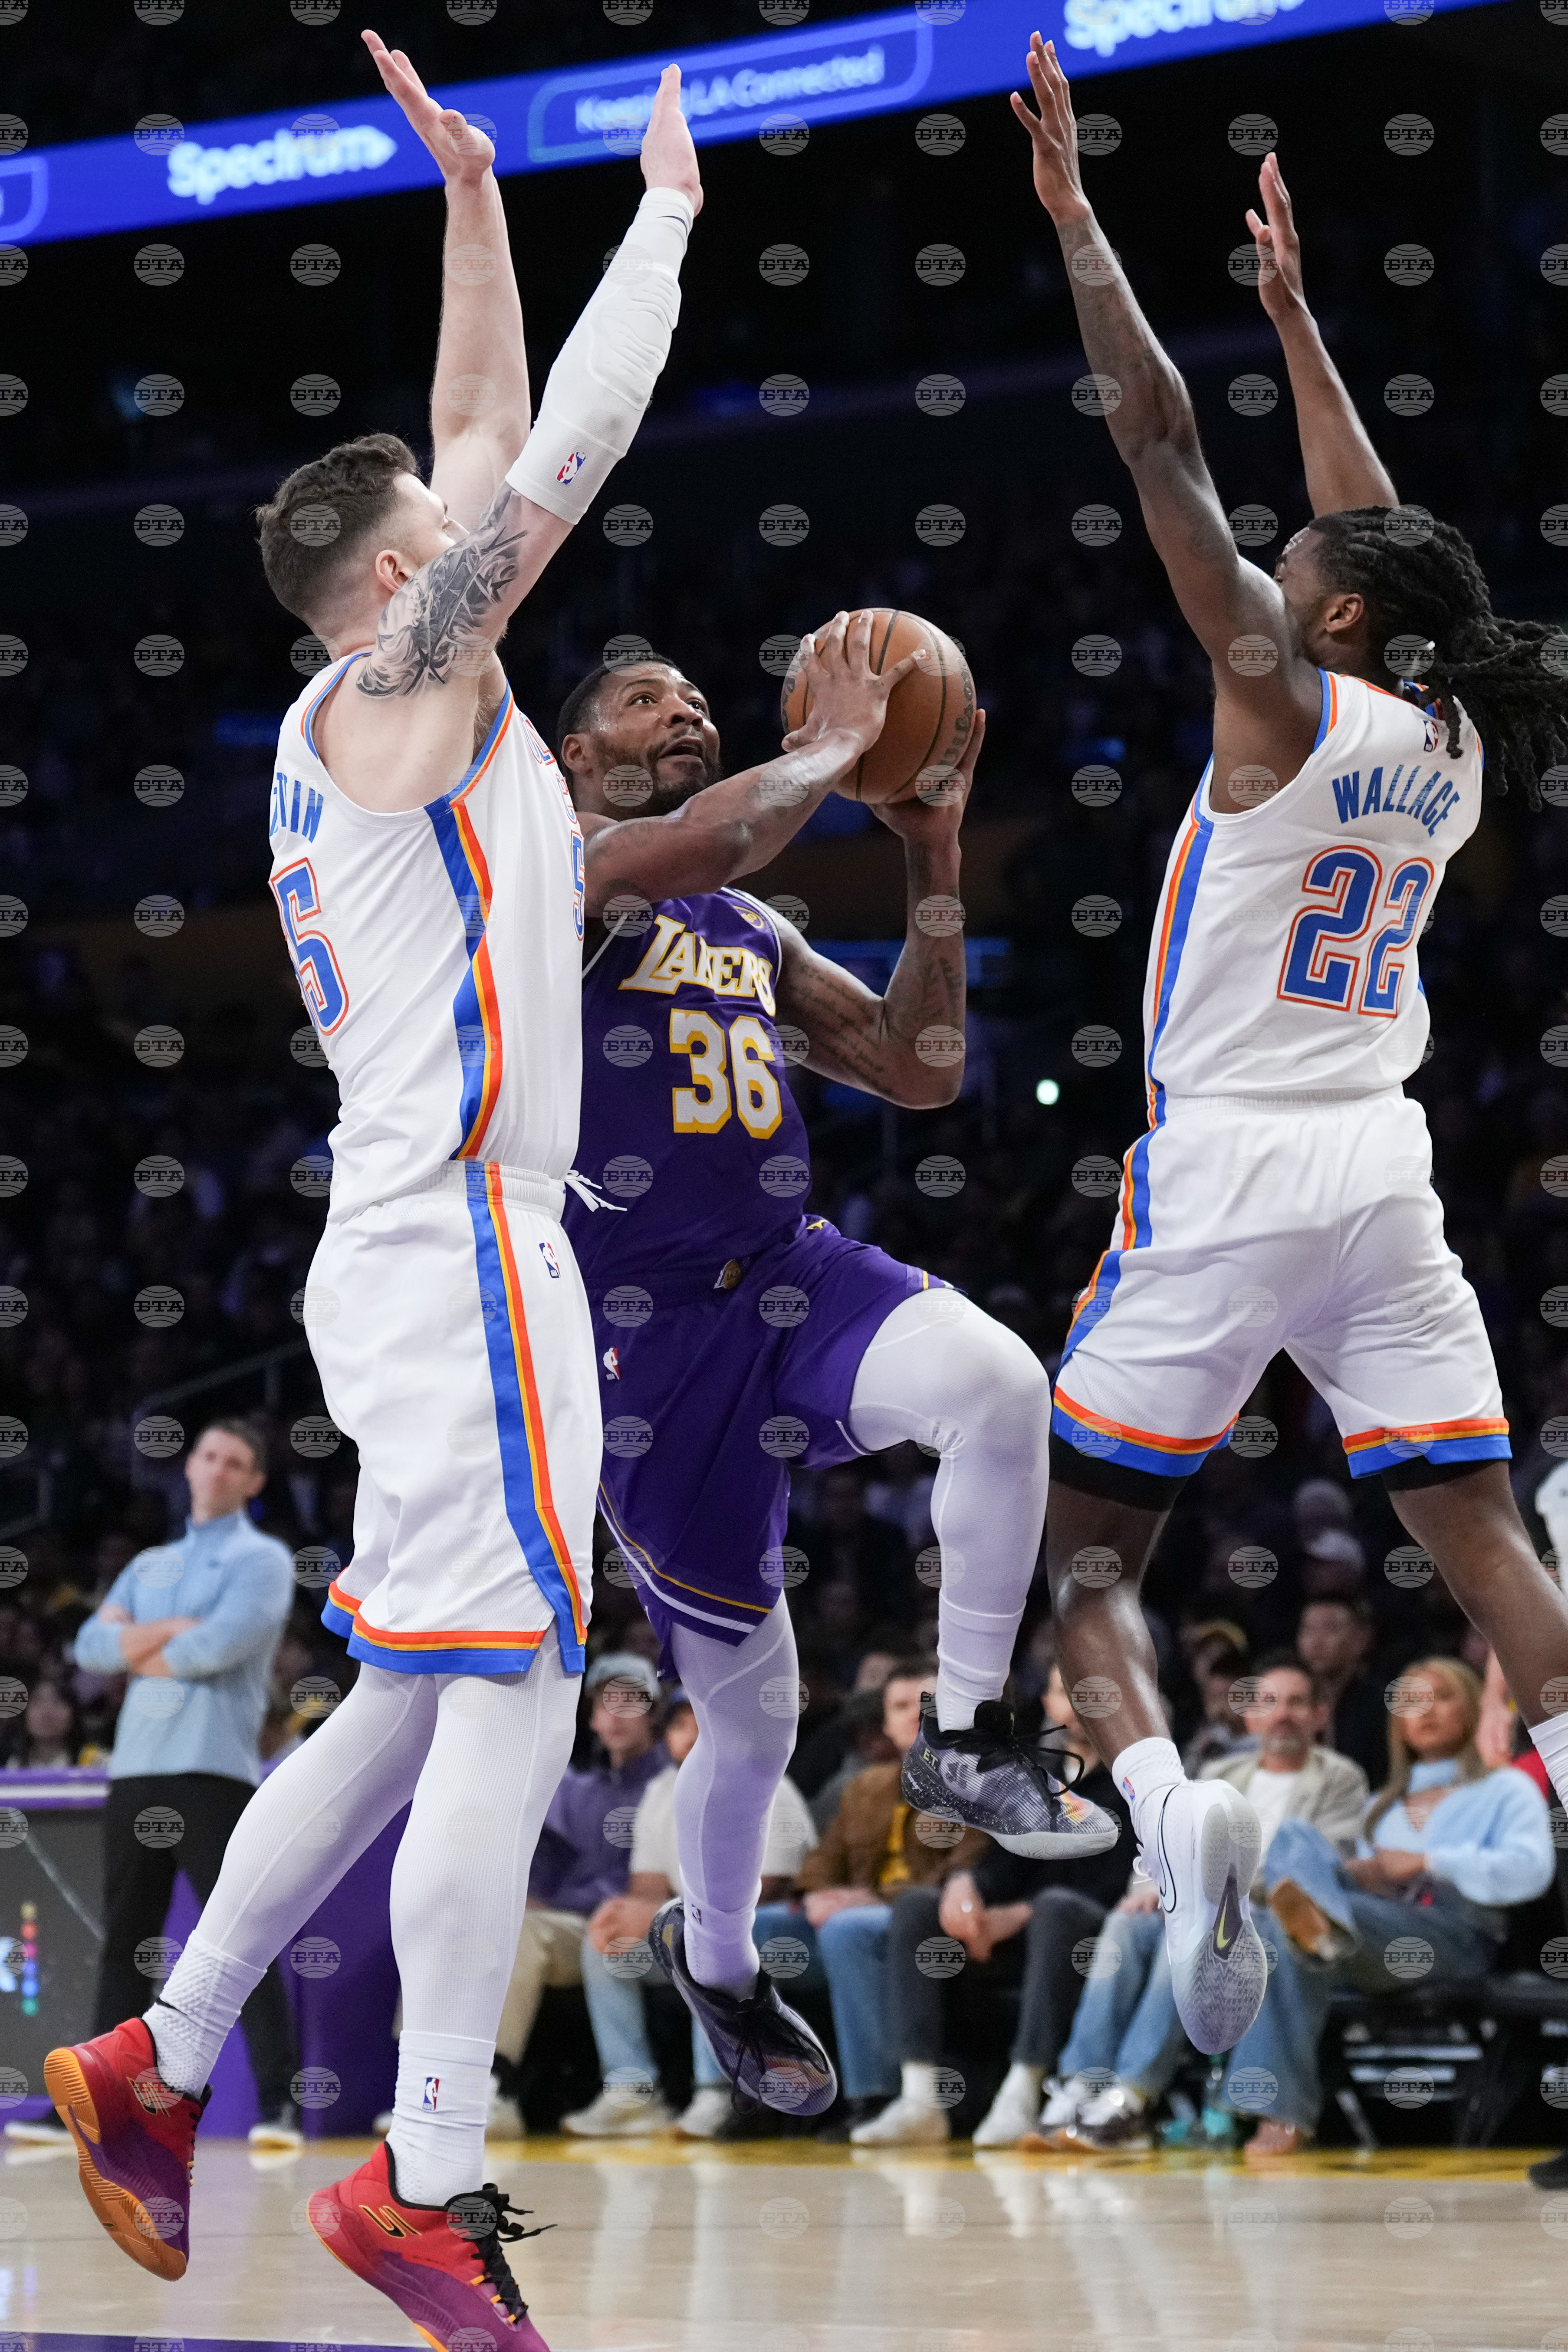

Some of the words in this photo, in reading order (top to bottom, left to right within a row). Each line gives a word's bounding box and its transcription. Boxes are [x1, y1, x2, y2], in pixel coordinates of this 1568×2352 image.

[168, 125, 392, 204] Spectrum
[1333, 765, 1461, 837] WALLACE
[618, 914, 776, 1017] LAKERS
[1277, 845, 1435, 1019] 22
[669, 1008, 782, 1139] 36
